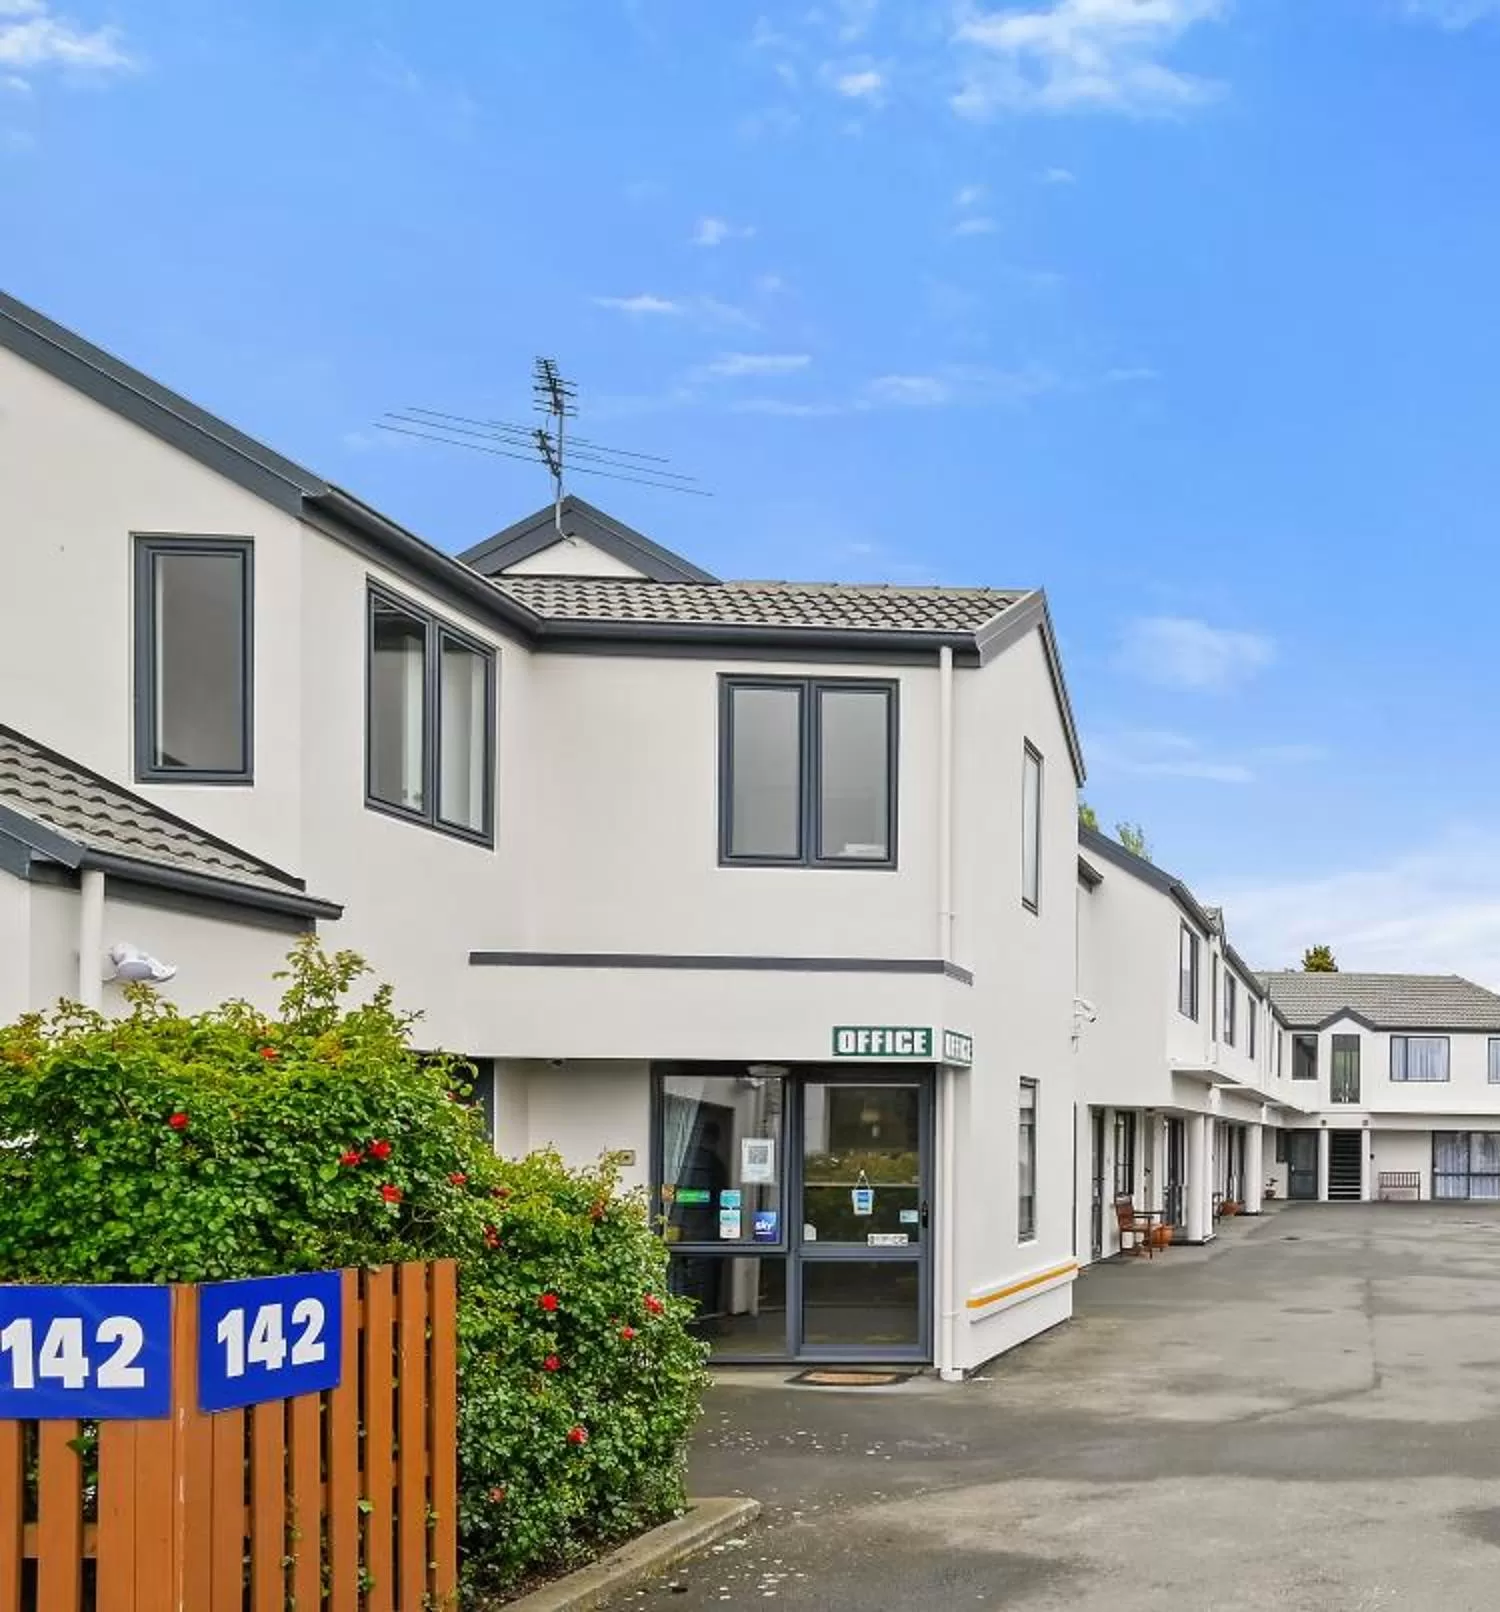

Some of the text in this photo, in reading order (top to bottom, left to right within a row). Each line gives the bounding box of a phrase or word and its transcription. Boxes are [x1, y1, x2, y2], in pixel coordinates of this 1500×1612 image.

[837, 1029, 927, 1054] OFFICE
[0, 1315, 146, 1389] 142
[217, 1298, 326, 1378] 142
